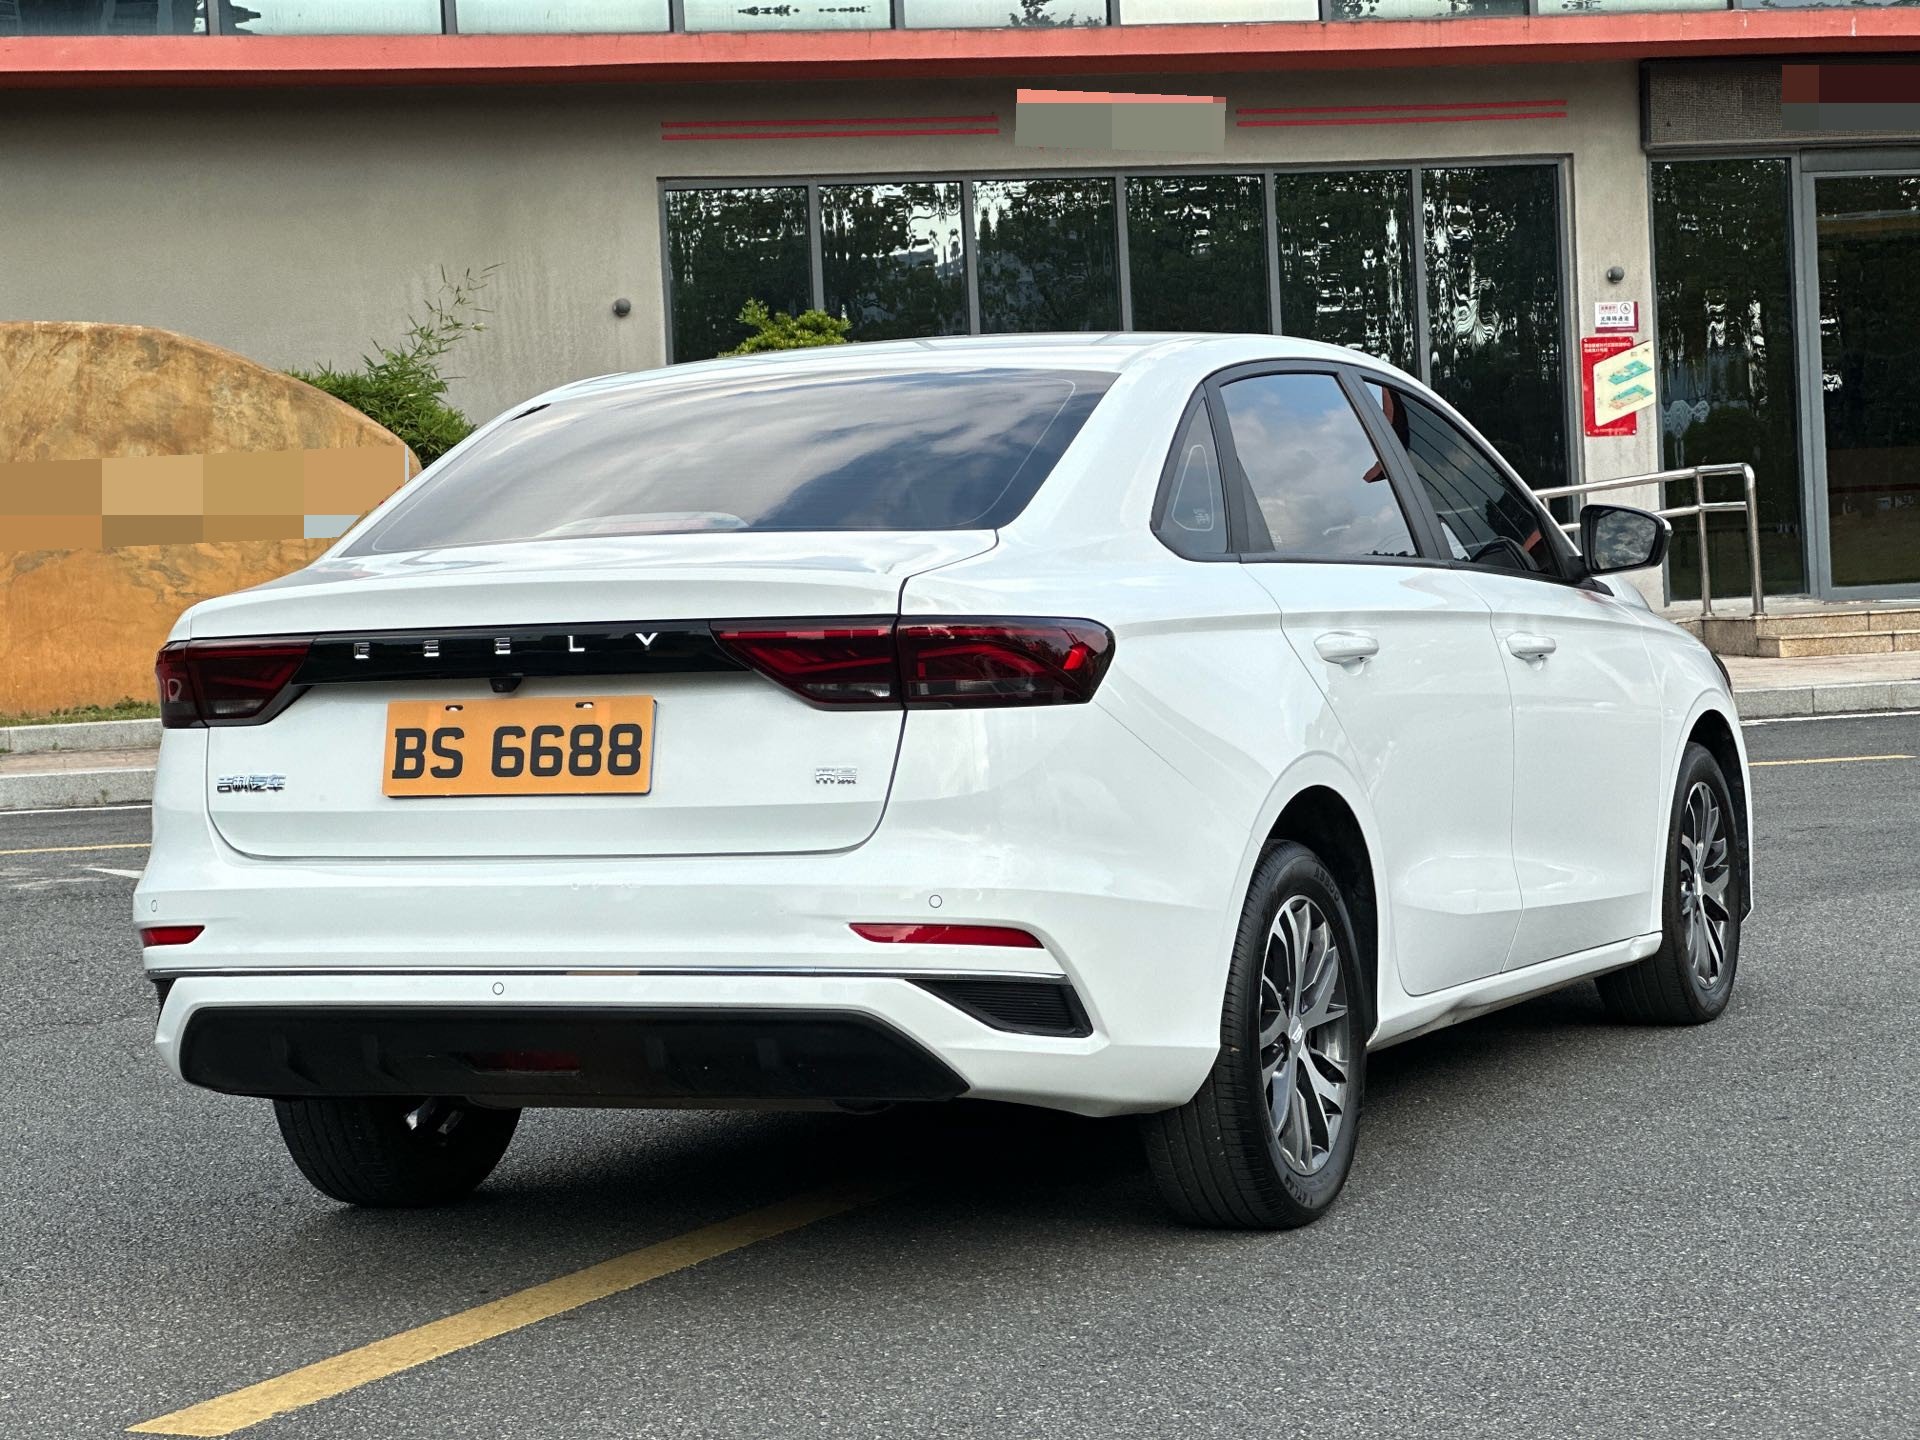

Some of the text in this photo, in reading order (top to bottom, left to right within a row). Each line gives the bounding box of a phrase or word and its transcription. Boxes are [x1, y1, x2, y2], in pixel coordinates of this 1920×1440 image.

[354, 632, 658, 660] GEELY
[392, 723, 643, 780] BS 6688
